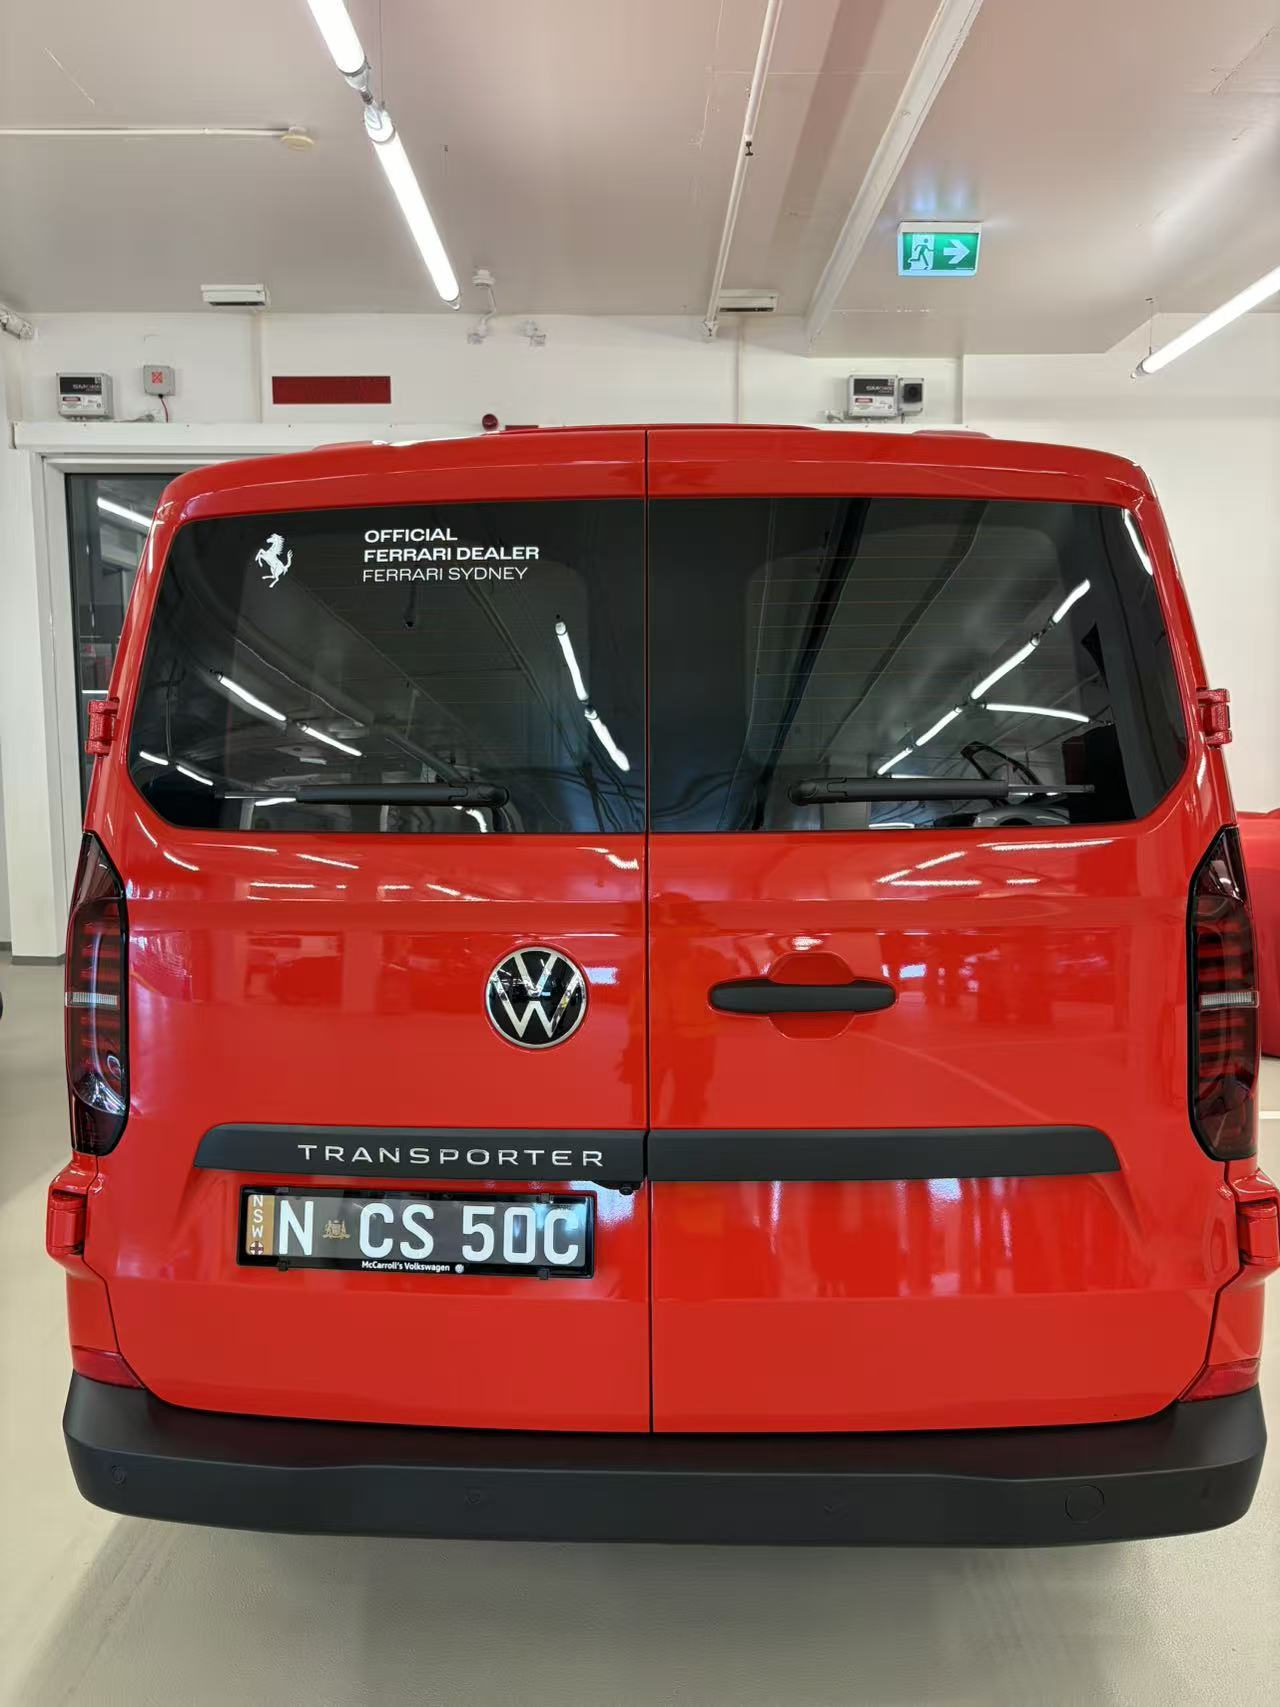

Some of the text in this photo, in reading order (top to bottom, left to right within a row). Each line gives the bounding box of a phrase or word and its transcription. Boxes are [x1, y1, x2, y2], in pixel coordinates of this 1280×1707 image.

[364, 528, 458, 543] OFFICIAL
[364, 546, 540, 563] FERRARI DEALER
[363, 566, 528, 583] FERRARI SYDNEY
[297, 1144, 604, 1167] TRANSPORTER
[251, 1194, 264, 1239] NSW
[278, 1199, 580, 1265] N CS 50C
[361, 1260, 403, 1271] McCarroll's
[404, 1262, 451, 1273] Volkswagen
